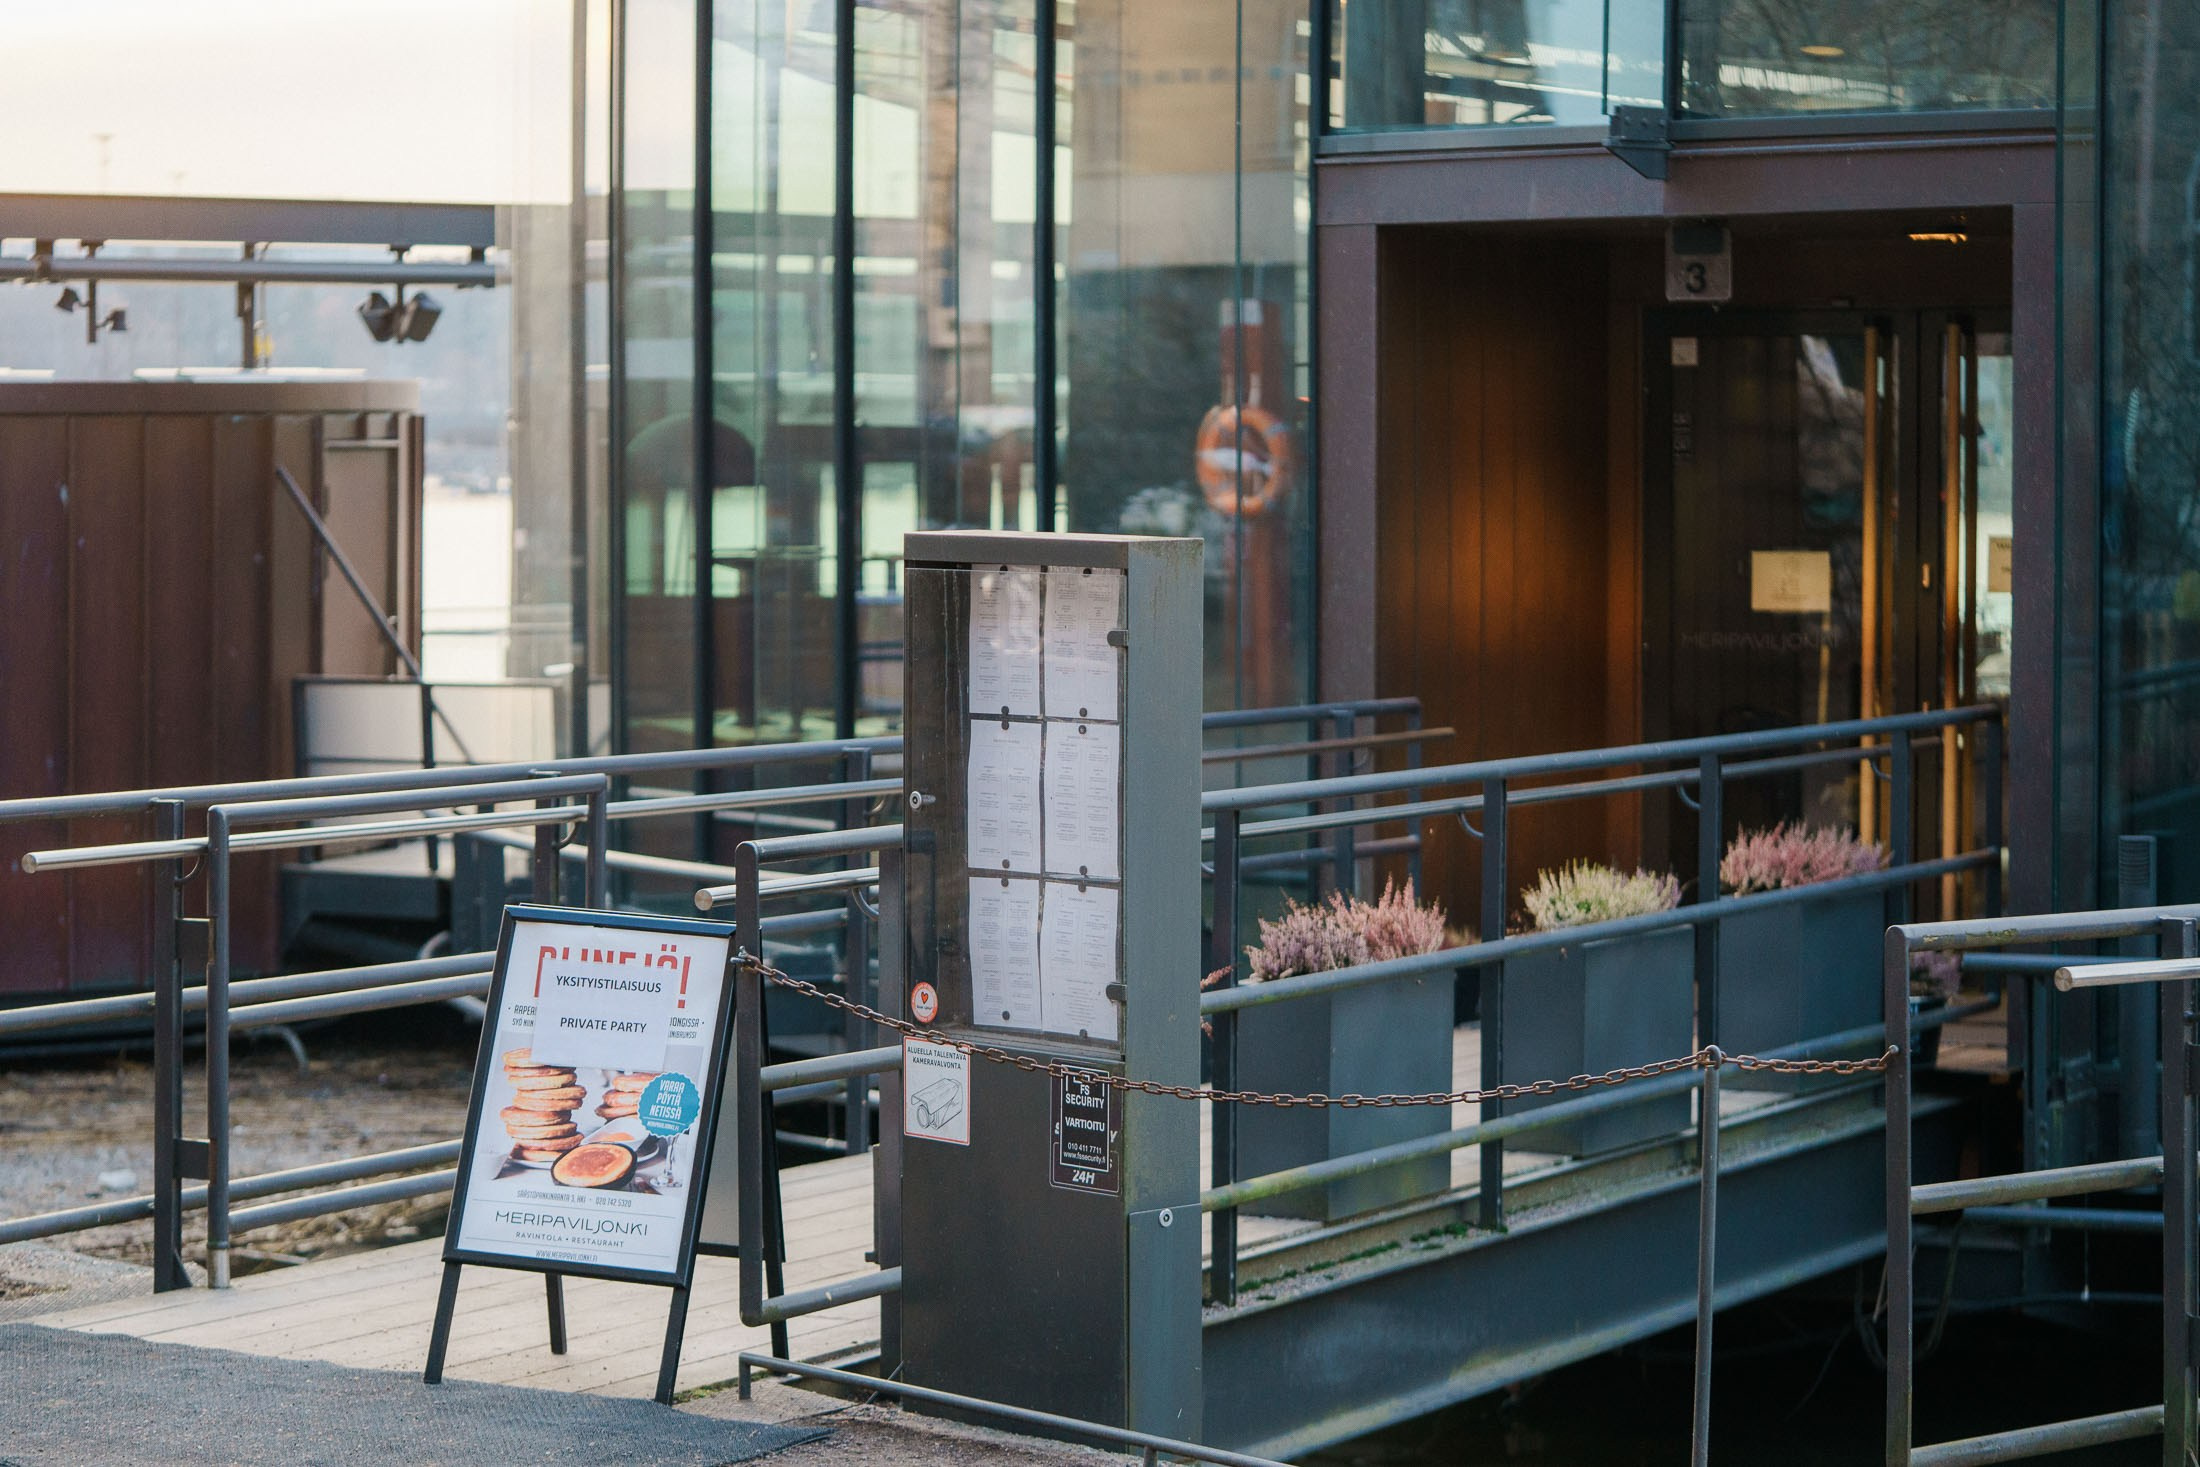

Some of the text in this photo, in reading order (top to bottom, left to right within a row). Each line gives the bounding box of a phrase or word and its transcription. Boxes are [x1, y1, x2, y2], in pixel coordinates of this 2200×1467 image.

[1685, 262, 1707, 294] 3
[556, 975, 662, 993] YKSITYISTILAISUUS
[560, 1017, 647, 1033] PRIVATE PARTY
[907, 1046, 967, 1061] ALUEELLA TALLENTAVA
[912, 1056, 962, 1070] KAMERAVALVONTA
[660, 1080, 686, 1094] VARAA
[1080, 1084, 1090, 1096] FS
[656, 1092, 682, 1106] PÖYTÄ
[1065, 1094, 1105, 1110] SECURITY
[649, 1104, 682, 1120] NETISSÄ
[1065, 1116, 1105, 1132] VARTIOITU
[1067, 1141, 1102, 1156] 010 411 7711
[1063, 1150, 1106, 1165] www.fssecurity.fi
[1072, 1169, 1096, 1185] 24H
[595, 1196, 606, 1205] 020
[607, 1197, 617, 1207] 742
[617, 1198, 632, 1208] 5320
[495, 1210, 648, 1236] MERIPAVILJONKI
[515, 1232, 625, 1248] RAVINTOLA RESTAURANT
